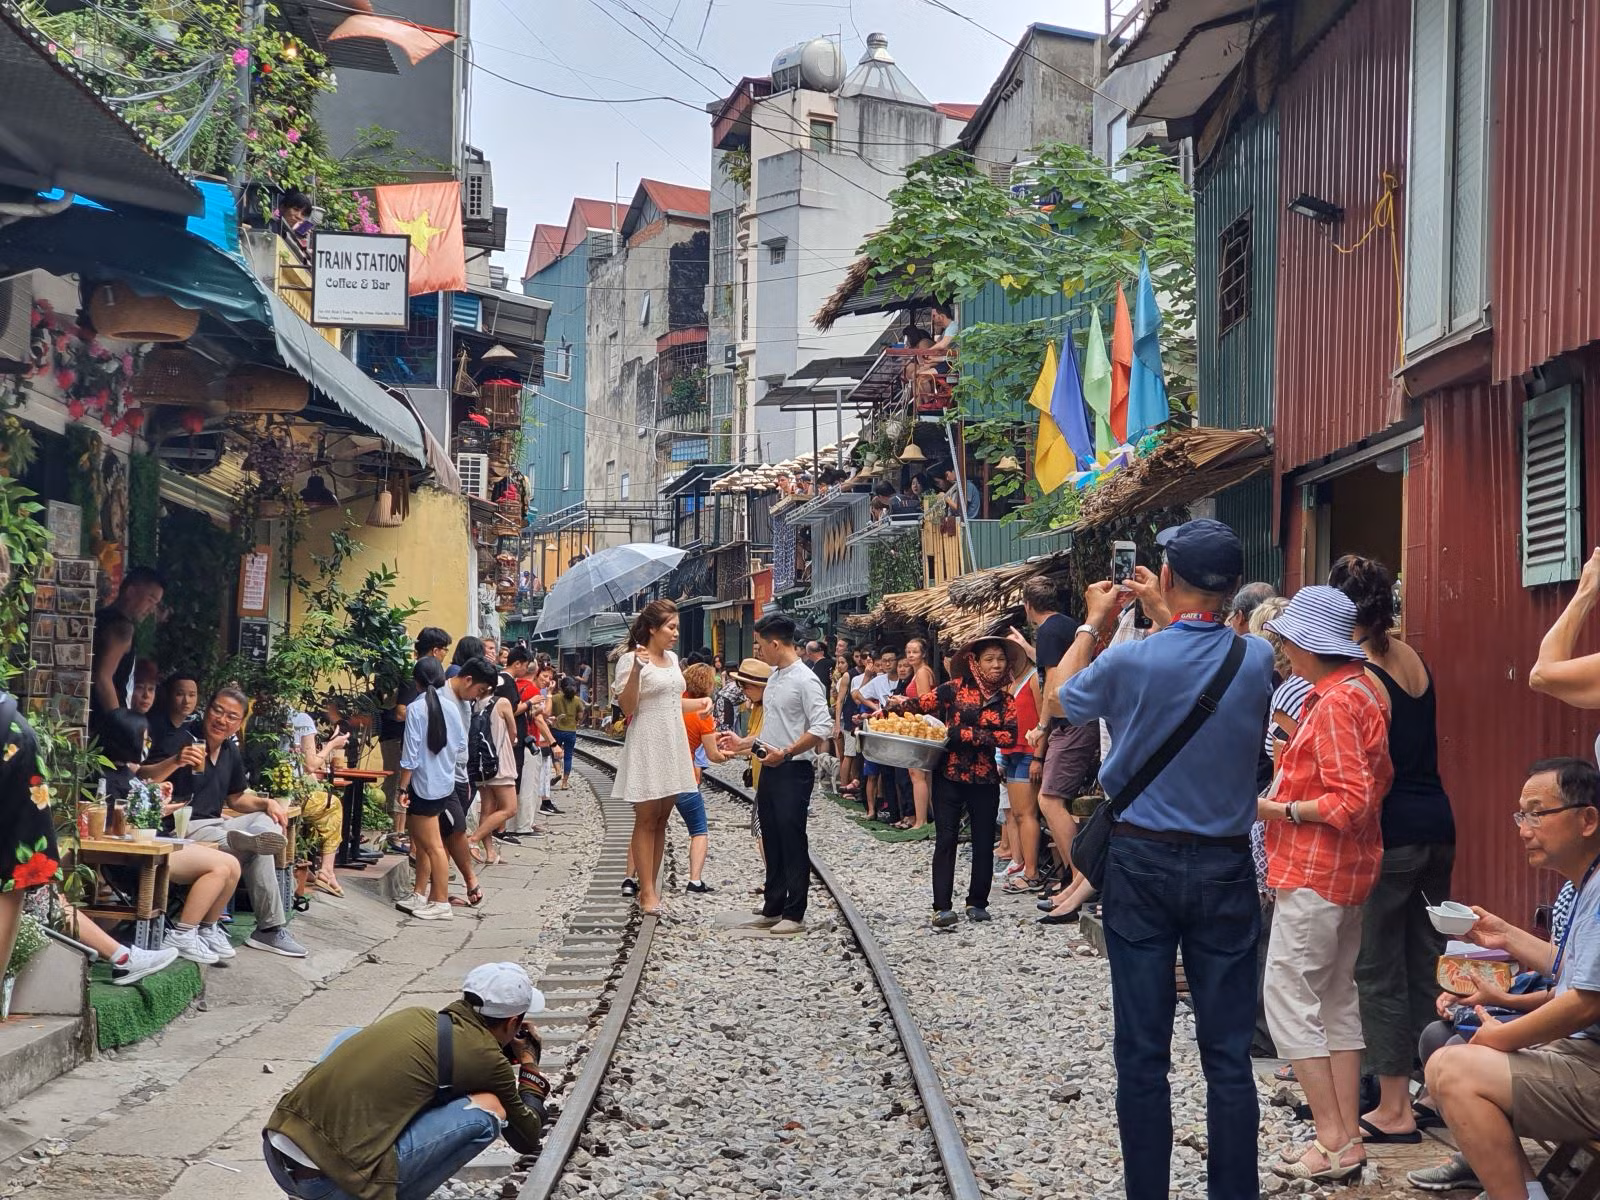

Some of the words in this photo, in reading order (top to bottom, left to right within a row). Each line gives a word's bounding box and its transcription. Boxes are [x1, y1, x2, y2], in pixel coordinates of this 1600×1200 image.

[317, 250, 352, 270] TRAIN
[356, 252, 406, 273] STATION
[325, 277, 358, 289] Coffee
[360, 278, 369, 290] &
[371, 279, 391, 291] Bar
[521, 1071, 546, 1088] Canon
